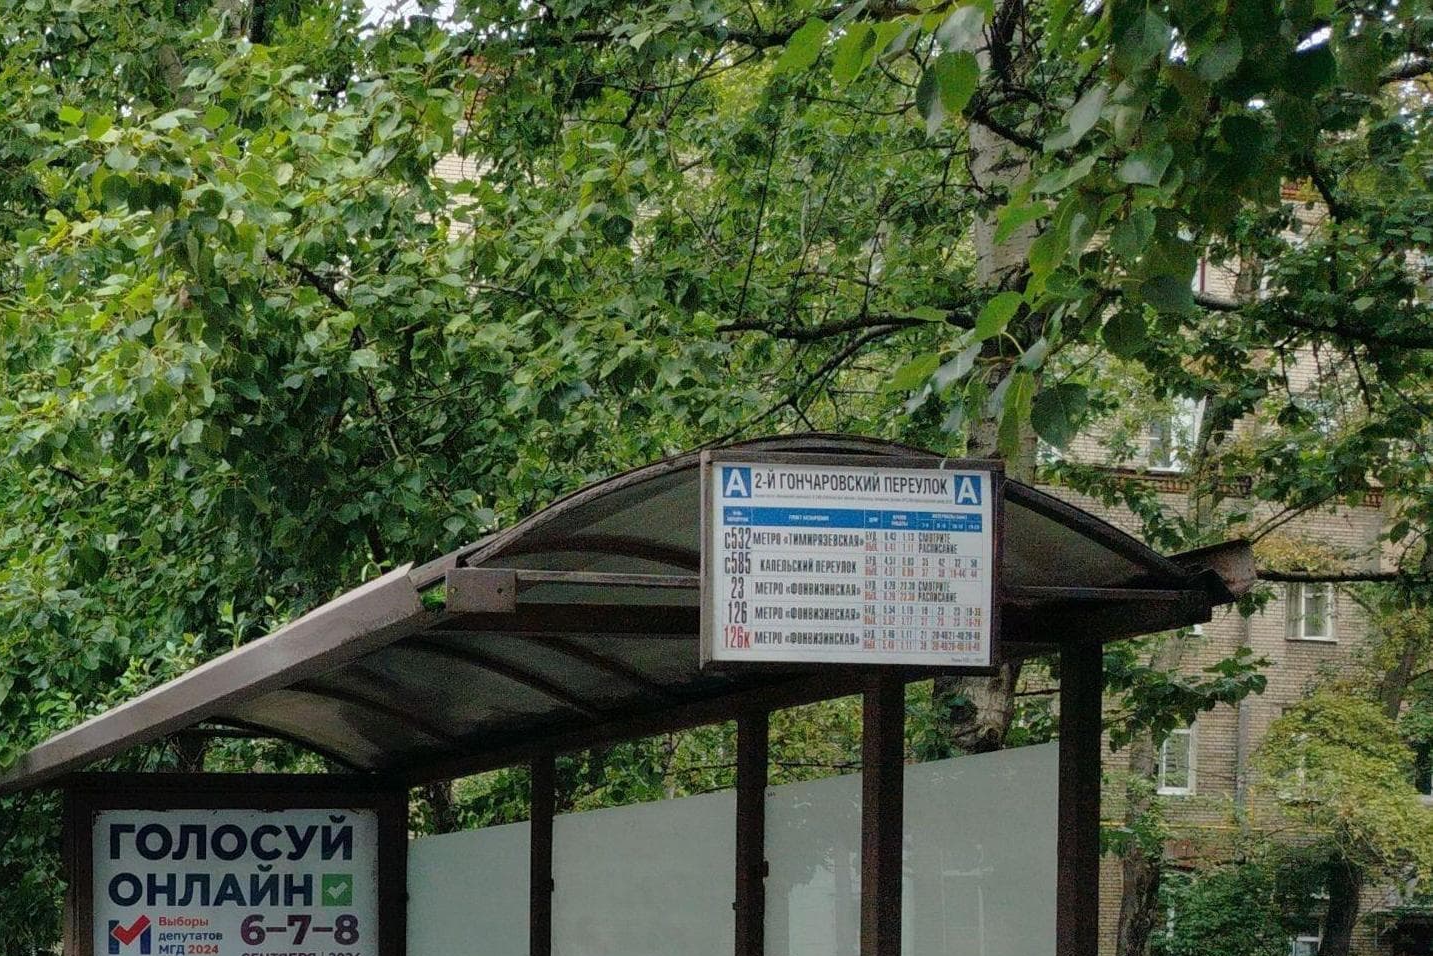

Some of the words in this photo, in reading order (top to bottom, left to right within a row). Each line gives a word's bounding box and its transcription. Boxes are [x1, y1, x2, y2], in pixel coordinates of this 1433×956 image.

[725, 468, 750, 496] А
[754, 469, 776, 489] 2-Й
[779, 470, 881, 492] ГОНЧАРОВСКИЙ
[884, 475, 948, 495] ПЕРЕУЛОК
[957, 476, 978, 504] А
[753, 532, 782, 545] МЕТРО
[783, 533, 865, 548] «ТИМИРЯЗЕВСКАЯ»
[760, 558, 814, 573] КАПЕЛЬСКИЙ
[816, 560, 857, 574] ПЕРЕУЛОК
[731, 576, 745, 600] 23
[755, 582, 784, 595] МЕТРО
[785, 582, 861, 596] «ФОНВИЗИНСКАЯ»
[728, 601, 748, 624] 126
[755, 606, 783, 620] МЕТРО
[785, 607, 860, 621] «ФОНВИЗИНСКАЯ»
[754, 632, 782, 645] МЕТРО
[784, 632, 860, 646] «ФОНВИЗИНСКАЯ»
[109, 815, 353, 861] ГОЛОСУЙ
[108, 864, 313, 907] ОНЛАЙН
[158, 916, 208, 929] Выборы
[158, 930, 223, 944] депутатов
[158, 945, 185, 956] МГД
[188, 944, 219, 955] 2024
